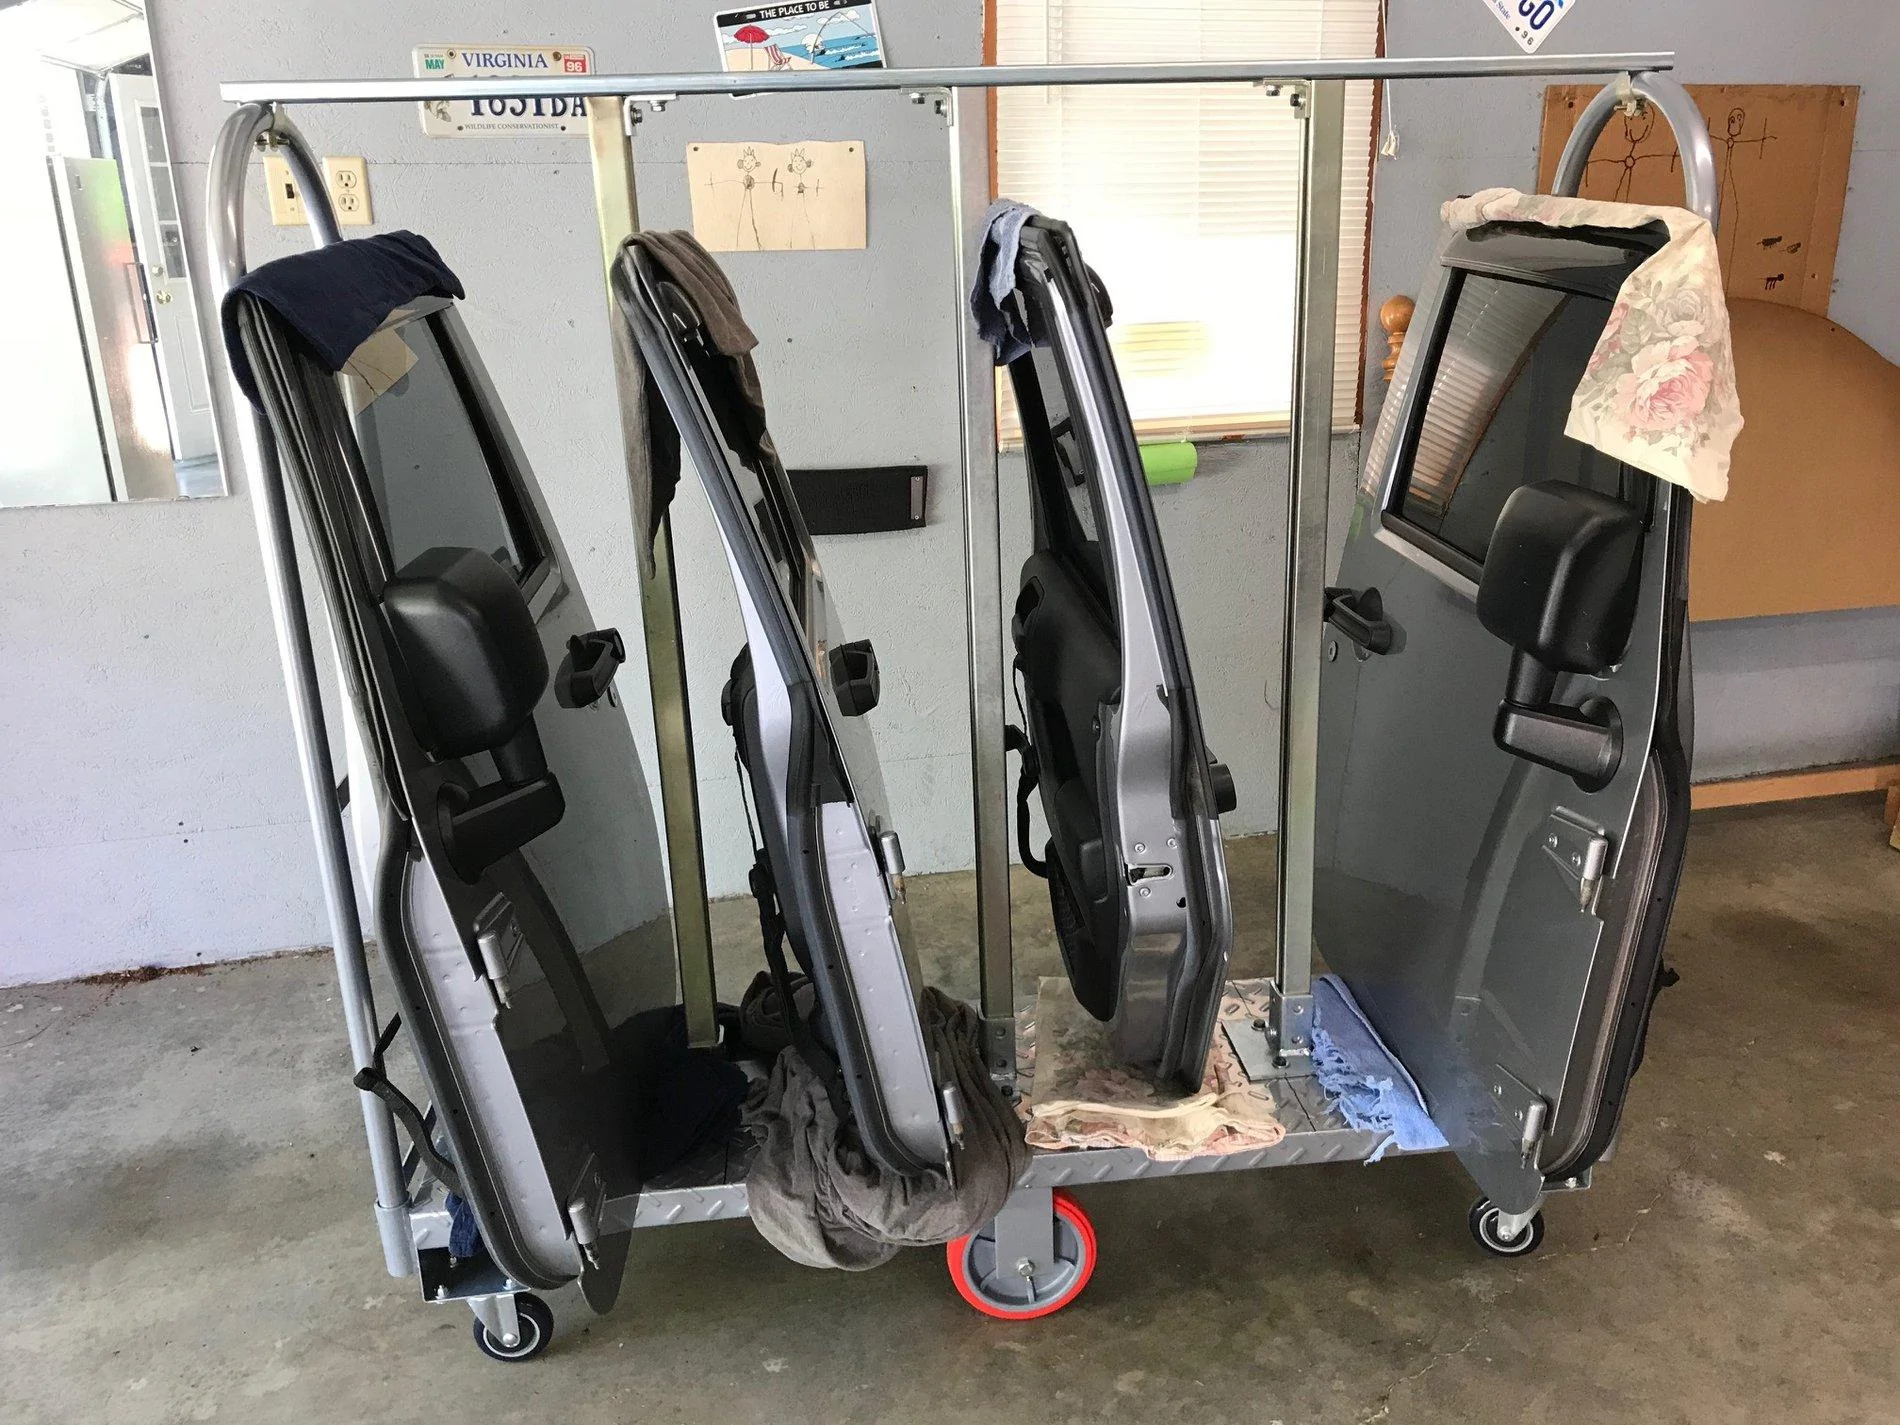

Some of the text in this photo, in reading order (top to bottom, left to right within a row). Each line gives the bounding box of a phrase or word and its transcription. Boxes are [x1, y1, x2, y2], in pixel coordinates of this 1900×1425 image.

[759, 9, 777, 19] THE
[778, 5, 804, 17] PLACE
[805, 2, 817, 12] TO
[818, 0, 830, 10] BE
[424, 59, 445, 70] MAY
[462, 52, 549, 69] VIRGINIA
